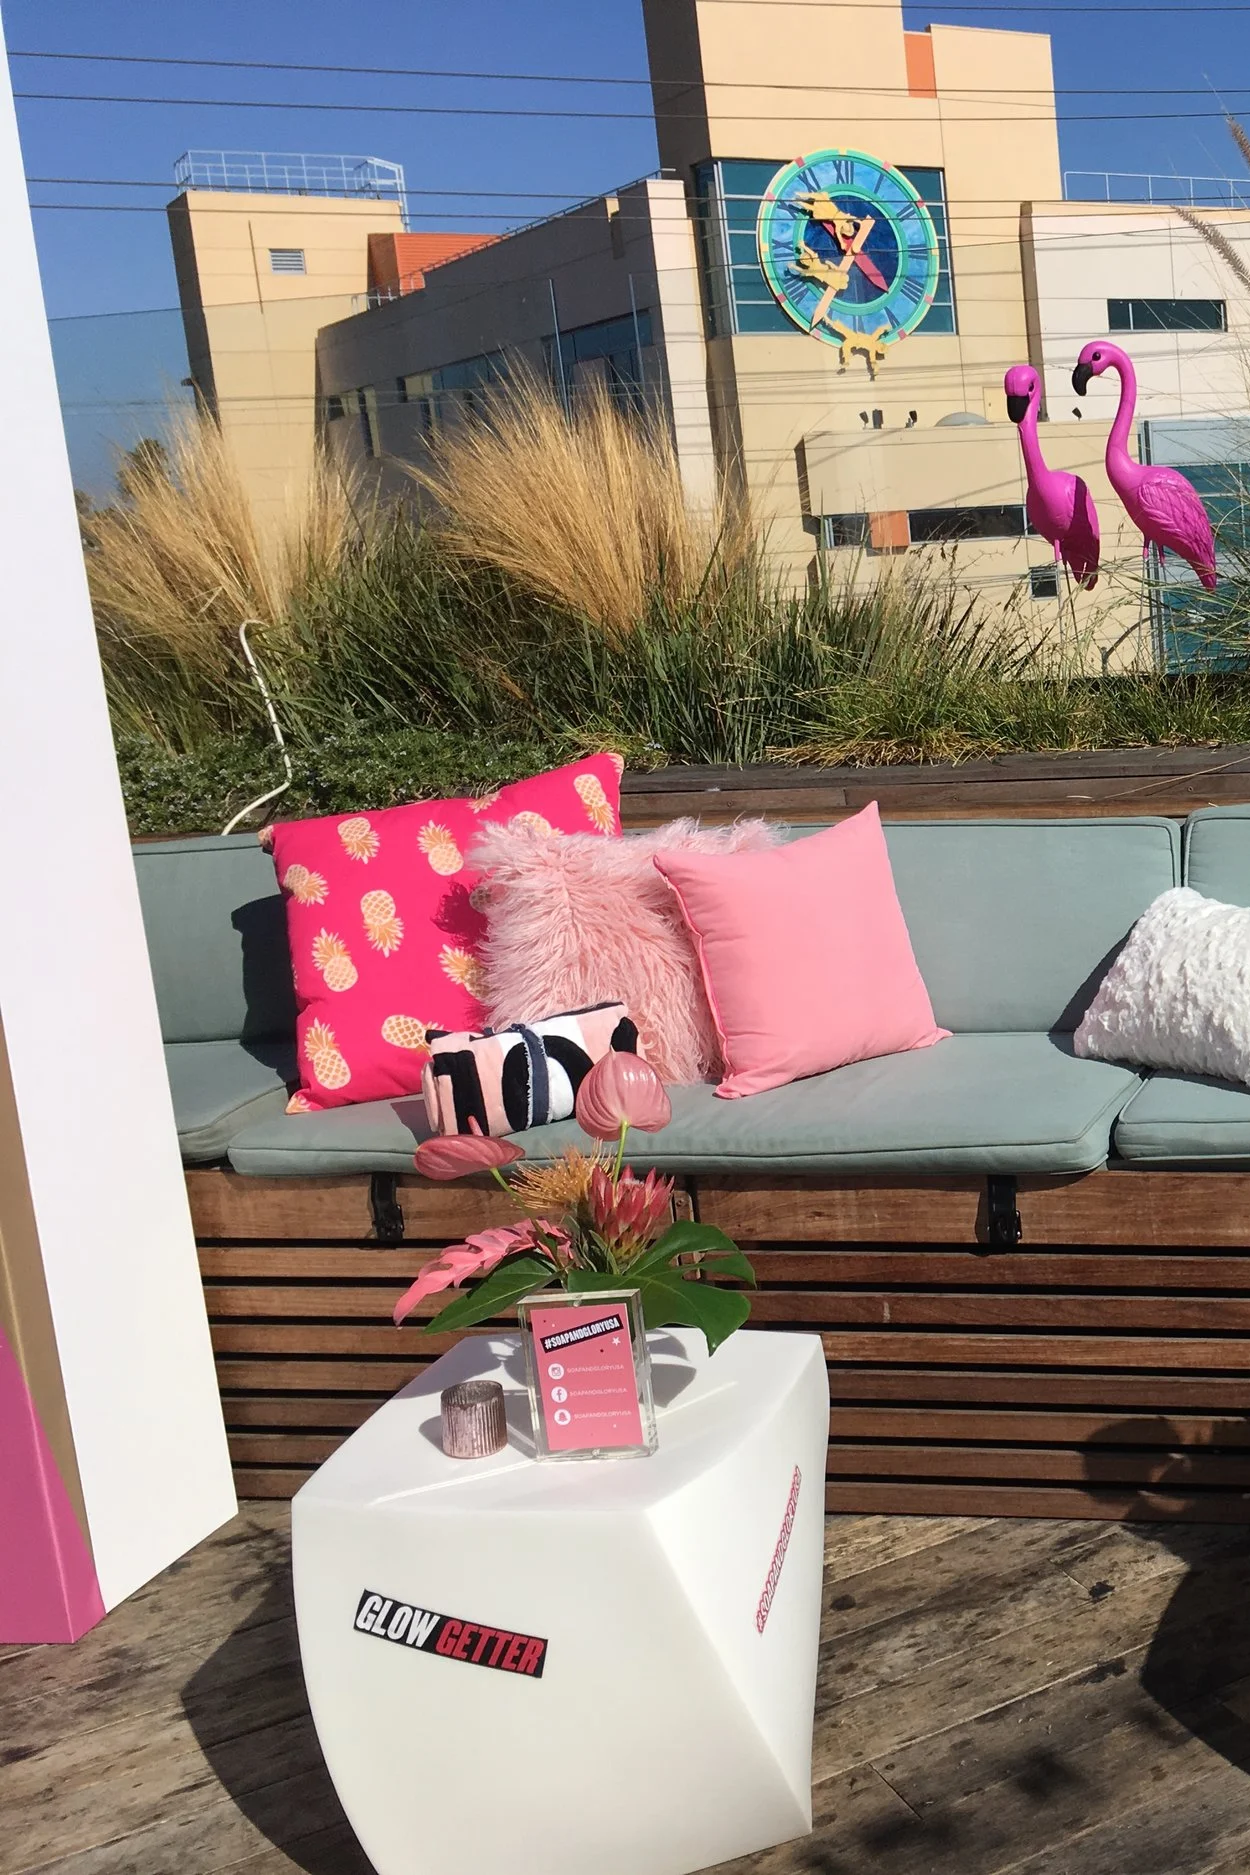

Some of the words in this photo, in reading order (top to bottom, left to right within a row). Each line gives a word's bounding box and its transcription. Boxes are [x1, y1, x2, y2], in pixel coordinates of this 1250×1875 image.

[797, 167, 822, 193] XI
[832, 160, 855, 185] XII
[896, 203, 917, 222] II
[772, 239, 795, 260] IX
[907, 243, 929, 261] III
[544, 1316, 620, 1350] #SOAPANDGLORYUSA
[355, 1594, 441, 1648] GLOW
[434, 1618, 545, 1675] GETTER
